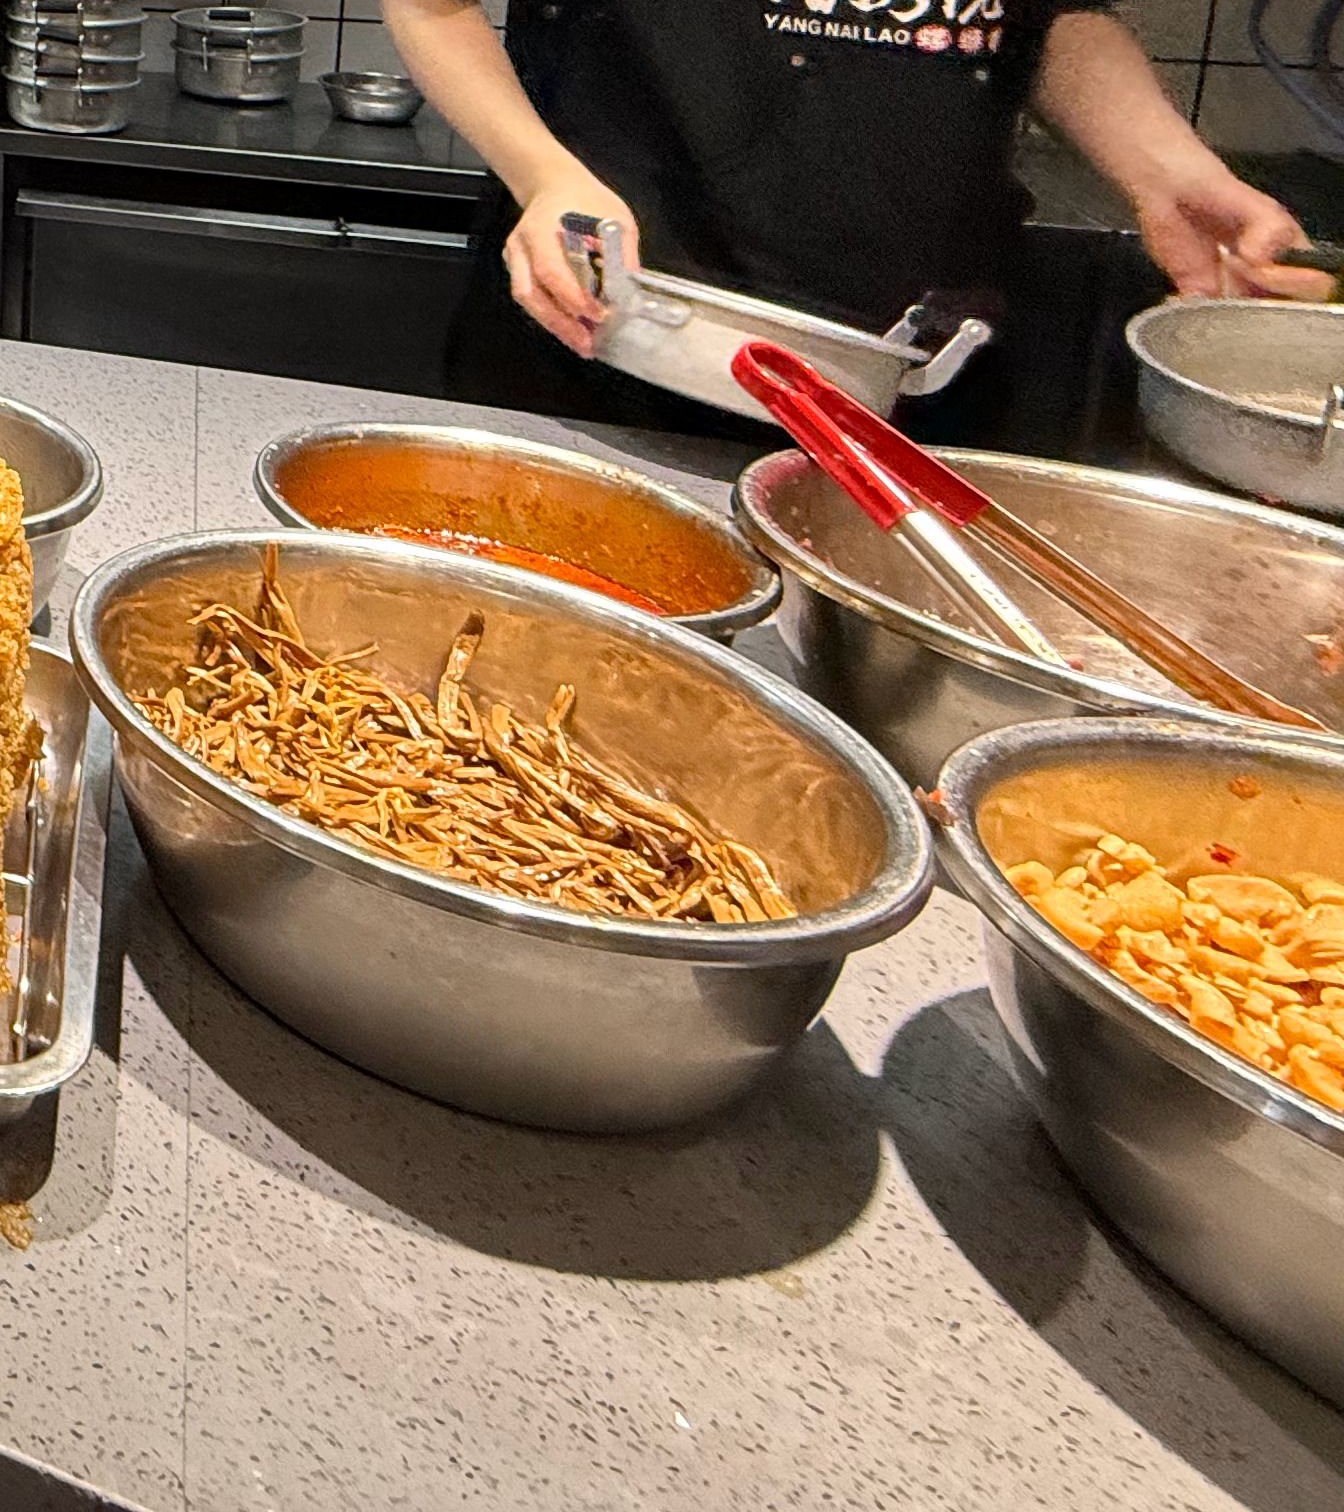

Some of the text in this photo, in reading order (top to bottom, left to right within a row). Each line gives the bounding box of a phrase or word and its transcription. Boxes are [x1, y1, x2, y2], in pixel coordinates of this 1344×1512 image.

[763, 13, 823, 36] YANG
[825, 22, 862, 42] NAI
[864, 26, 911, 46] LAO
